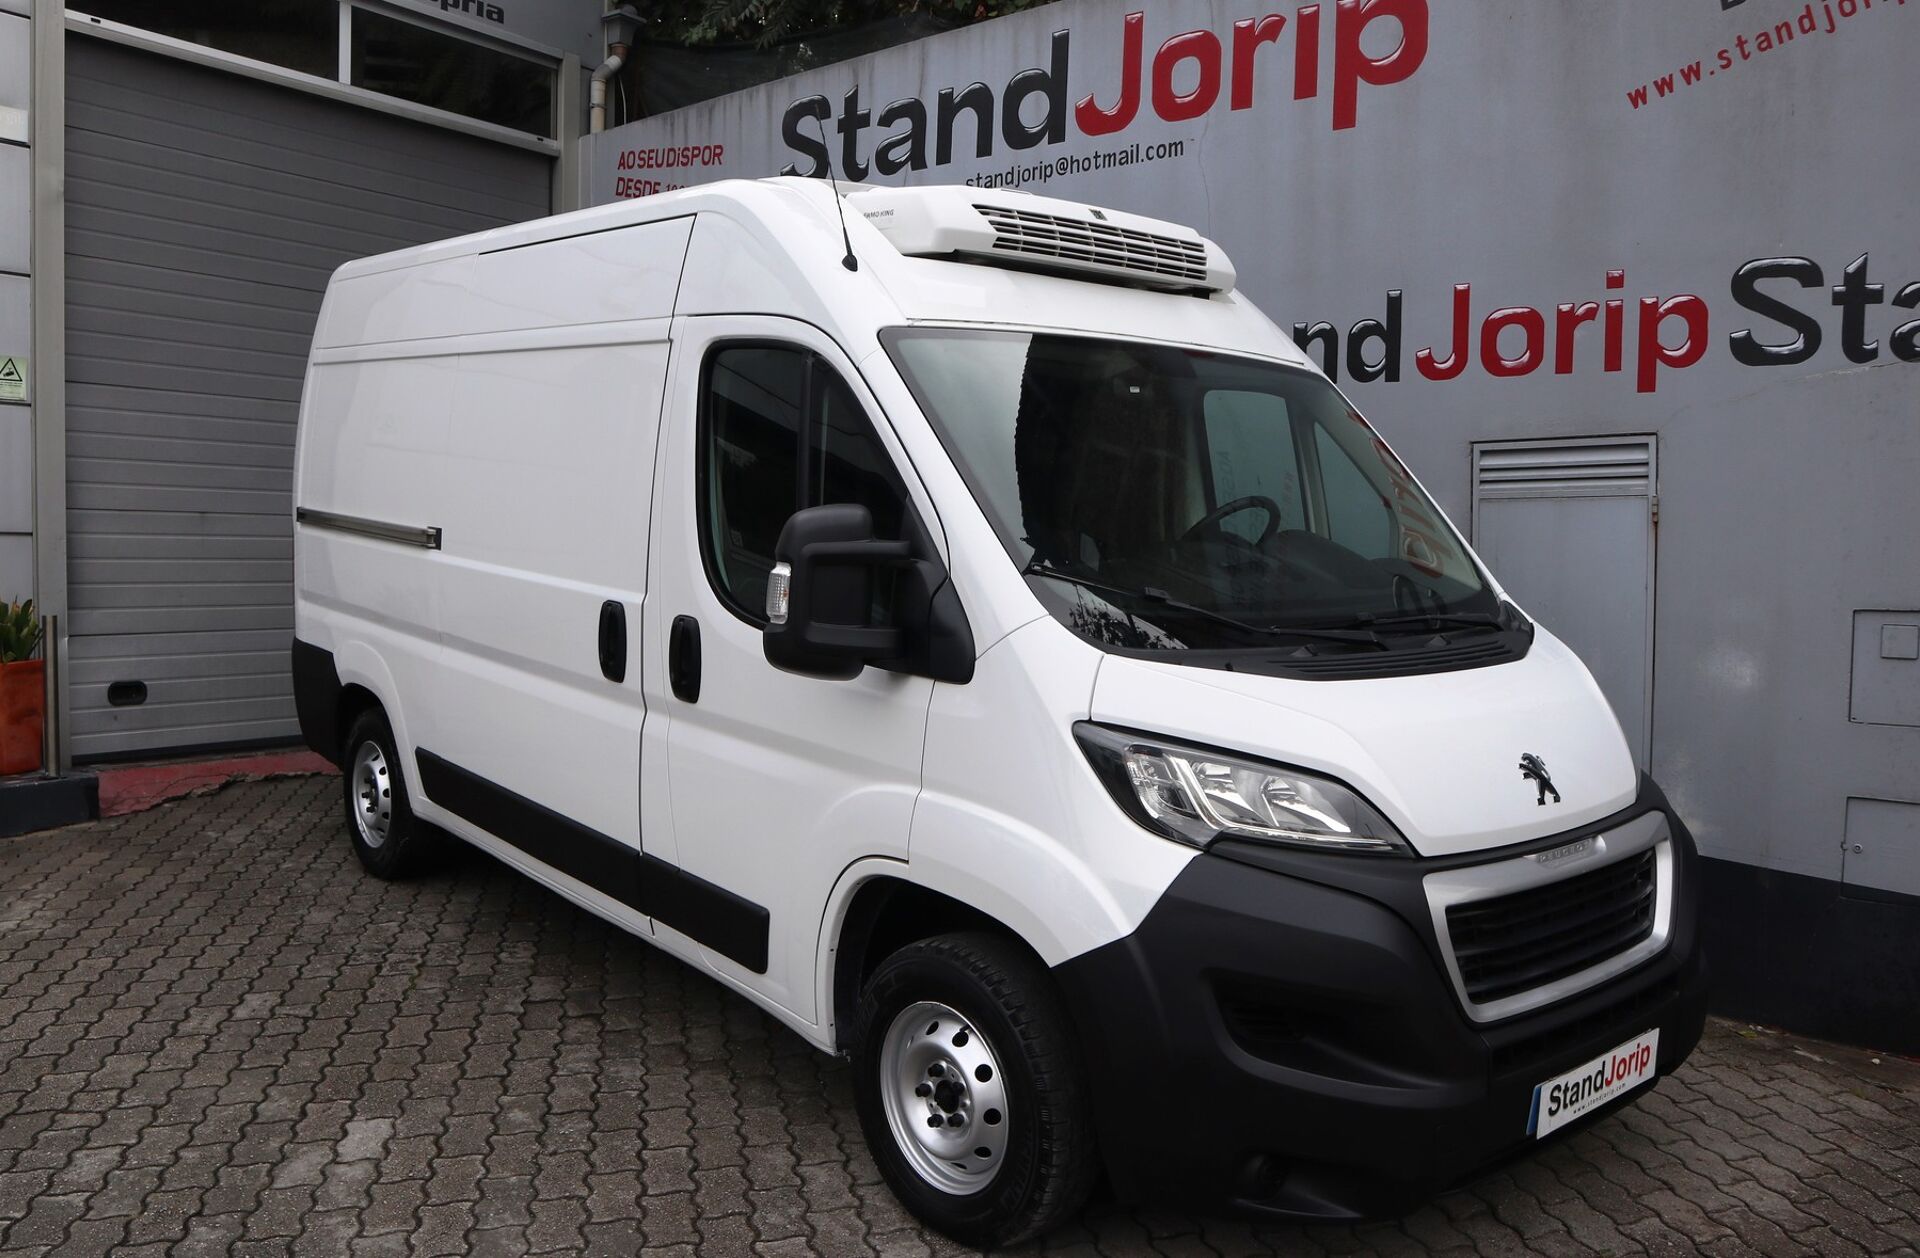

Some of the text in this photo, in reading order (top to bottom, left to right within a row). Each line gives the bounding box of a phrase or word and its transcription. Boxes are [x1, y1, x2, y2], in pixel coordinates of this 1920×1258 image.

[430, 0, 504, 24] pria
[780, 0, 1429, 181] StandJorip
[616, 176, 661, 198] DESDE
[966, 140, 1184, 189] standjorip@hotmail.com
[1548, 1042, 1651, 1117] StandJorip
